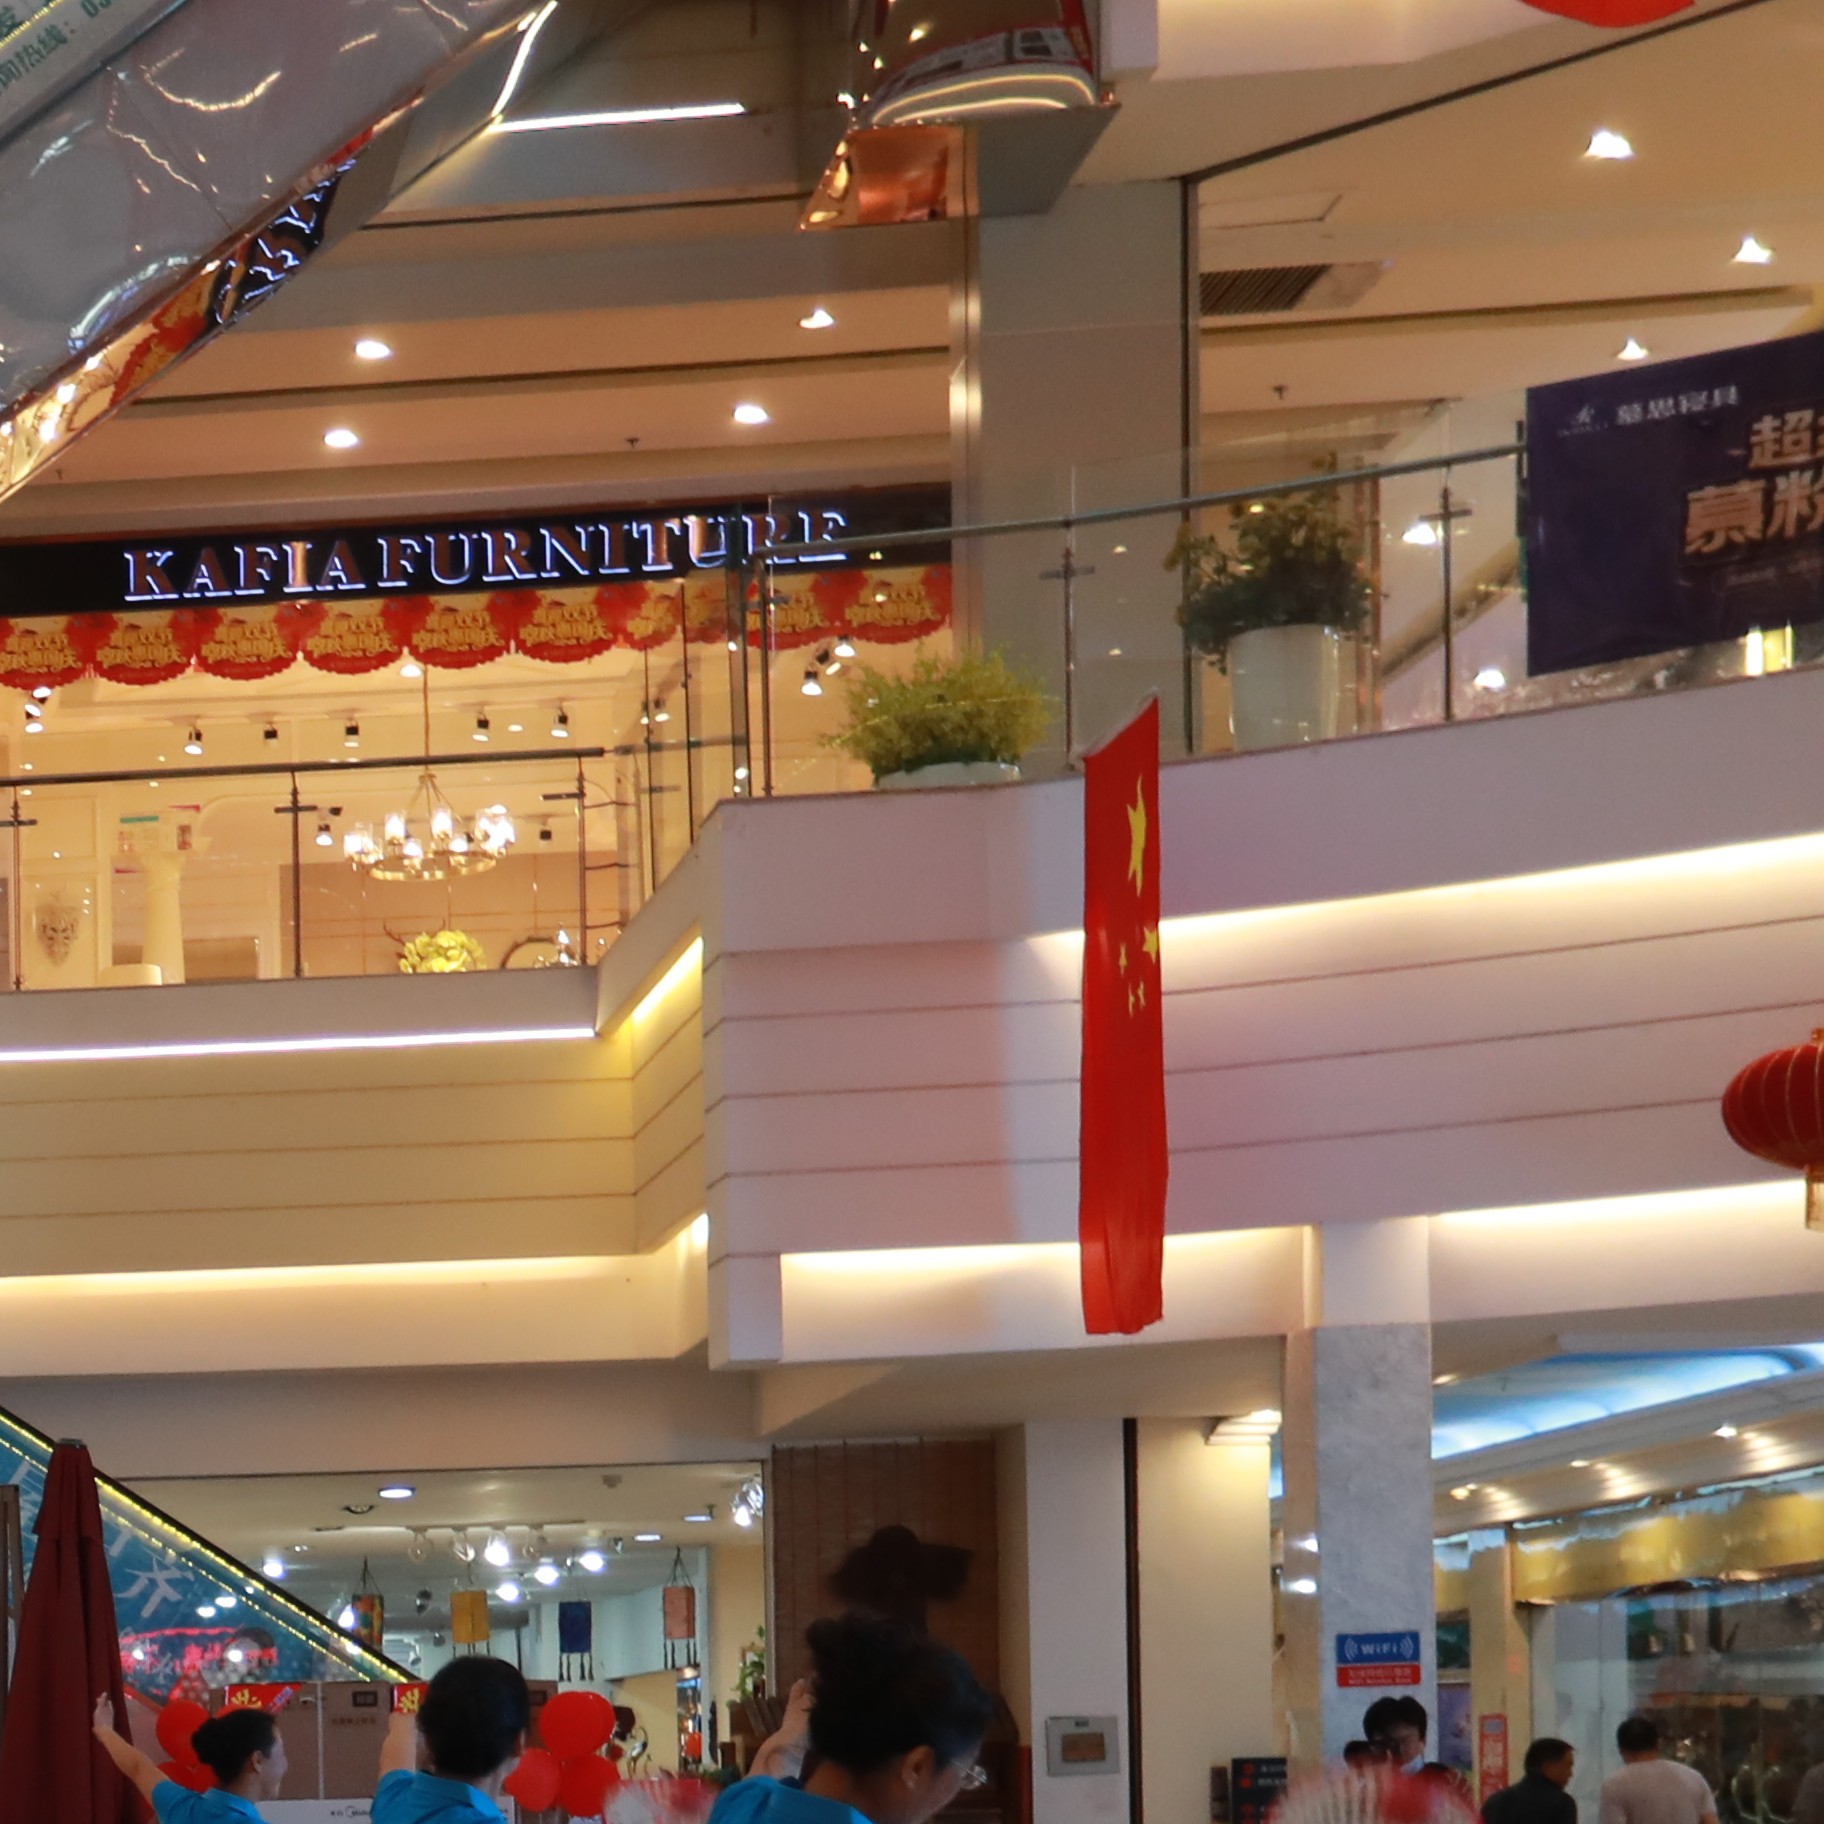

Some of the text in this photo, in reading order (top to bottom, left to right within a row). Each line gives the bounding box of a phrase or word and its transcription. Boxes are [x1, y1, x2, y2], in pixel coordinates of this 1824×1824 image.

[1749, 408, 1824, 469] 超
[124, 511, 849, 601] KAFIA FURNITURE
